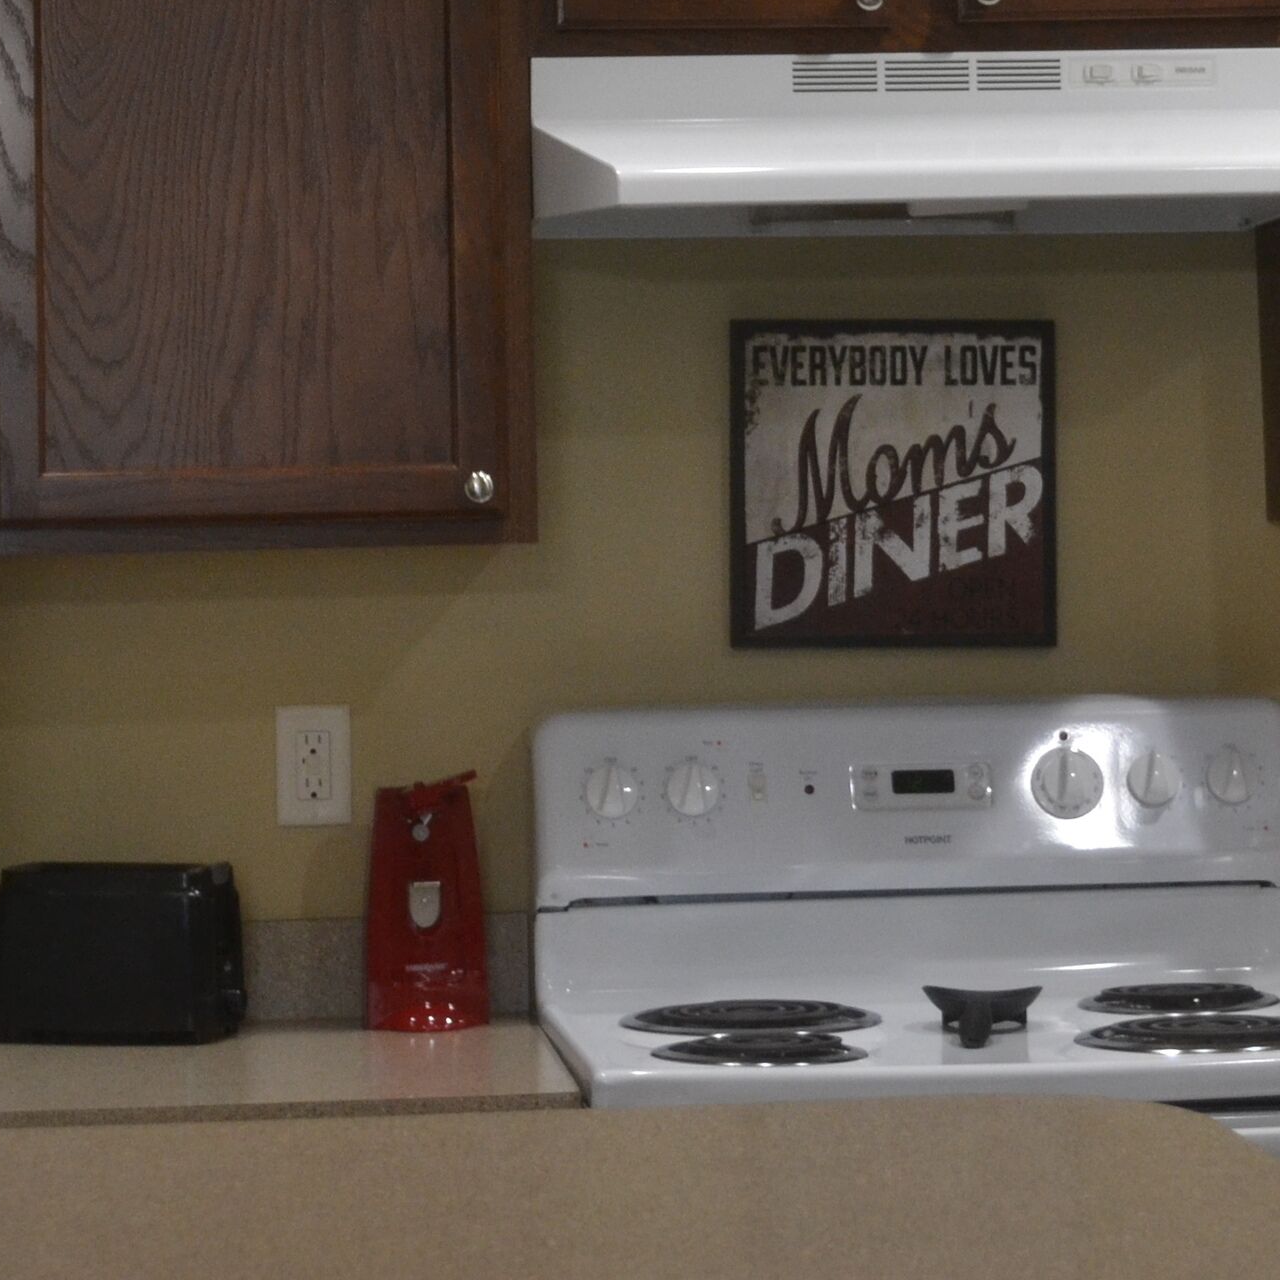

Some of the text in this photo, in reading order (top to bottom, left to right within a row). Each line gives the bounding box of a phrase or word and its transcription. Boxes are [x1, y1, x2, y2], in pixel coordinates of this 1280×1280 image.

[751, 344, 1038, 388] EVERYBODY LOVES
[770, 393, 1017, 534] Mom's
[754, 464, 1044, 631] DINER
